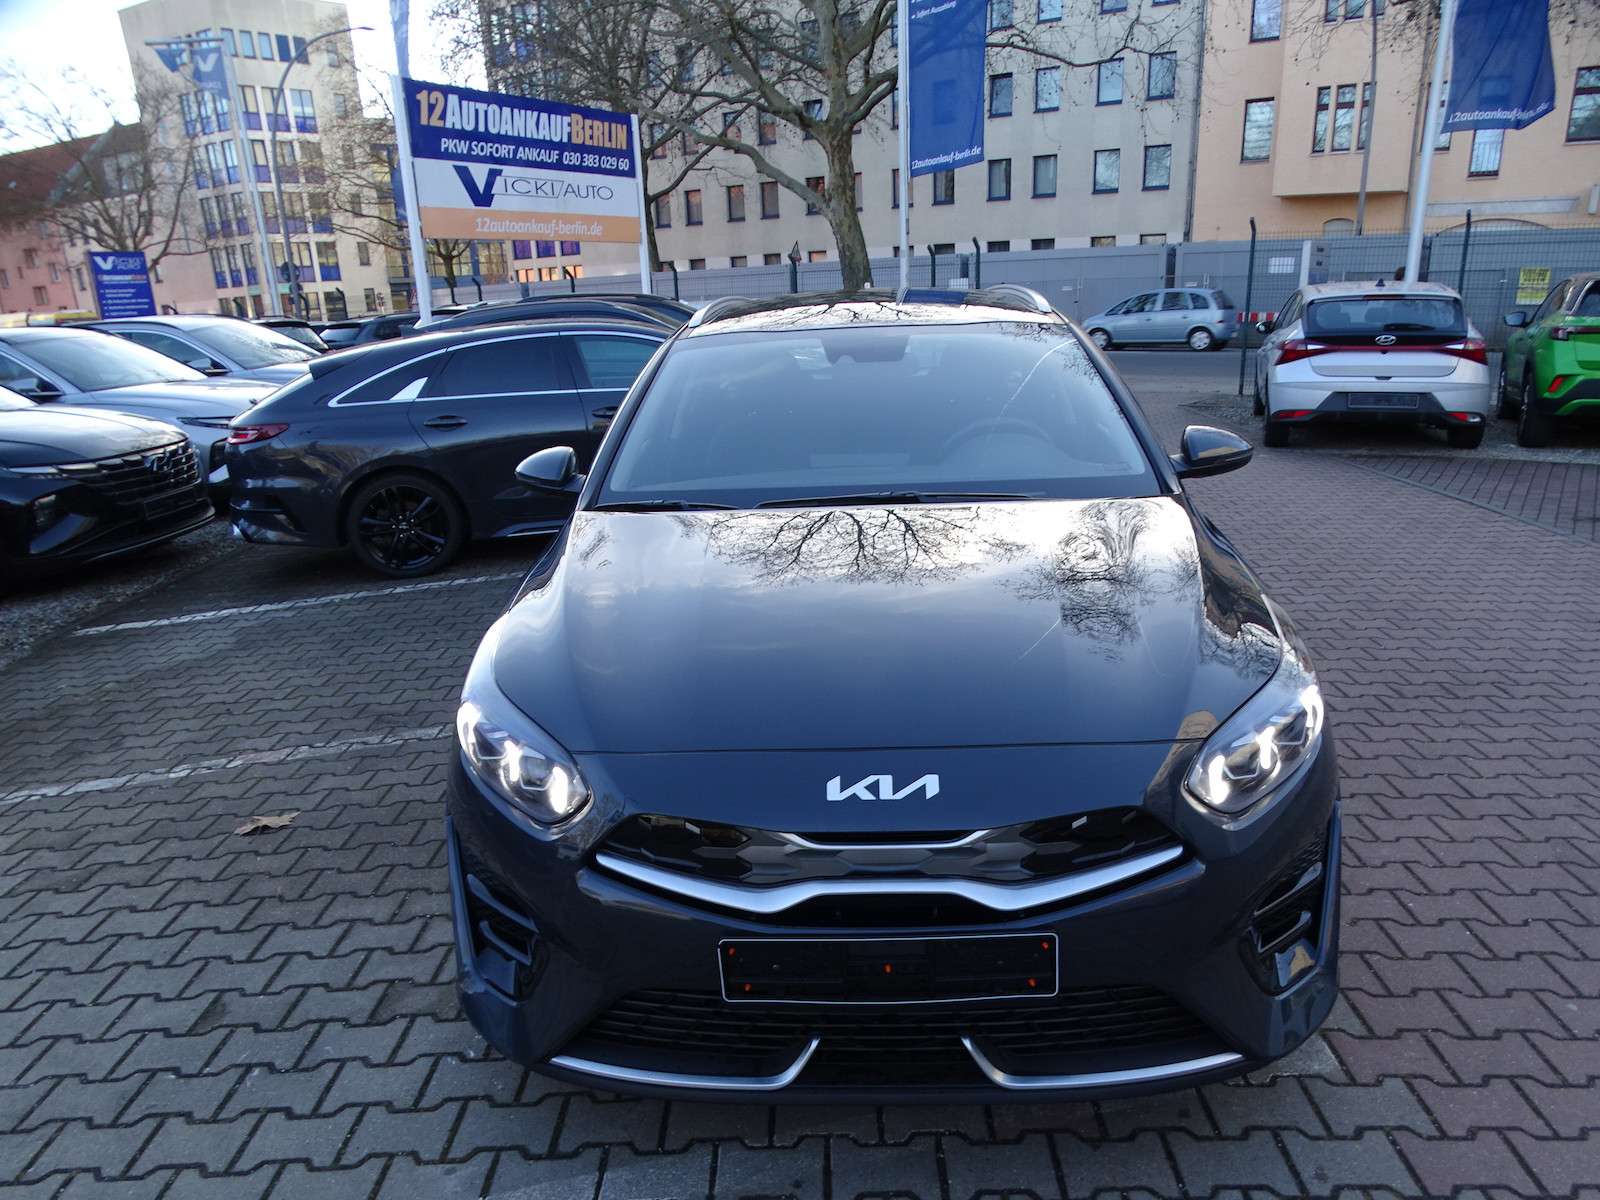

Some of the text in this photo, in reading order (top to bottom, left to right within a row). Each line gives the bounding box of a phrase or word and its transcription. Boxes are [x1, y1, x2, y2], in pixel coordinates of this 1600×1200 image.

[441, 138, 630, 171] PKW SOFORT ANKAUF 030 383 029 60
[475, 217, 603, 237] 12autoankauf-berlin.de
[826, 773, 940, 801] KIA
